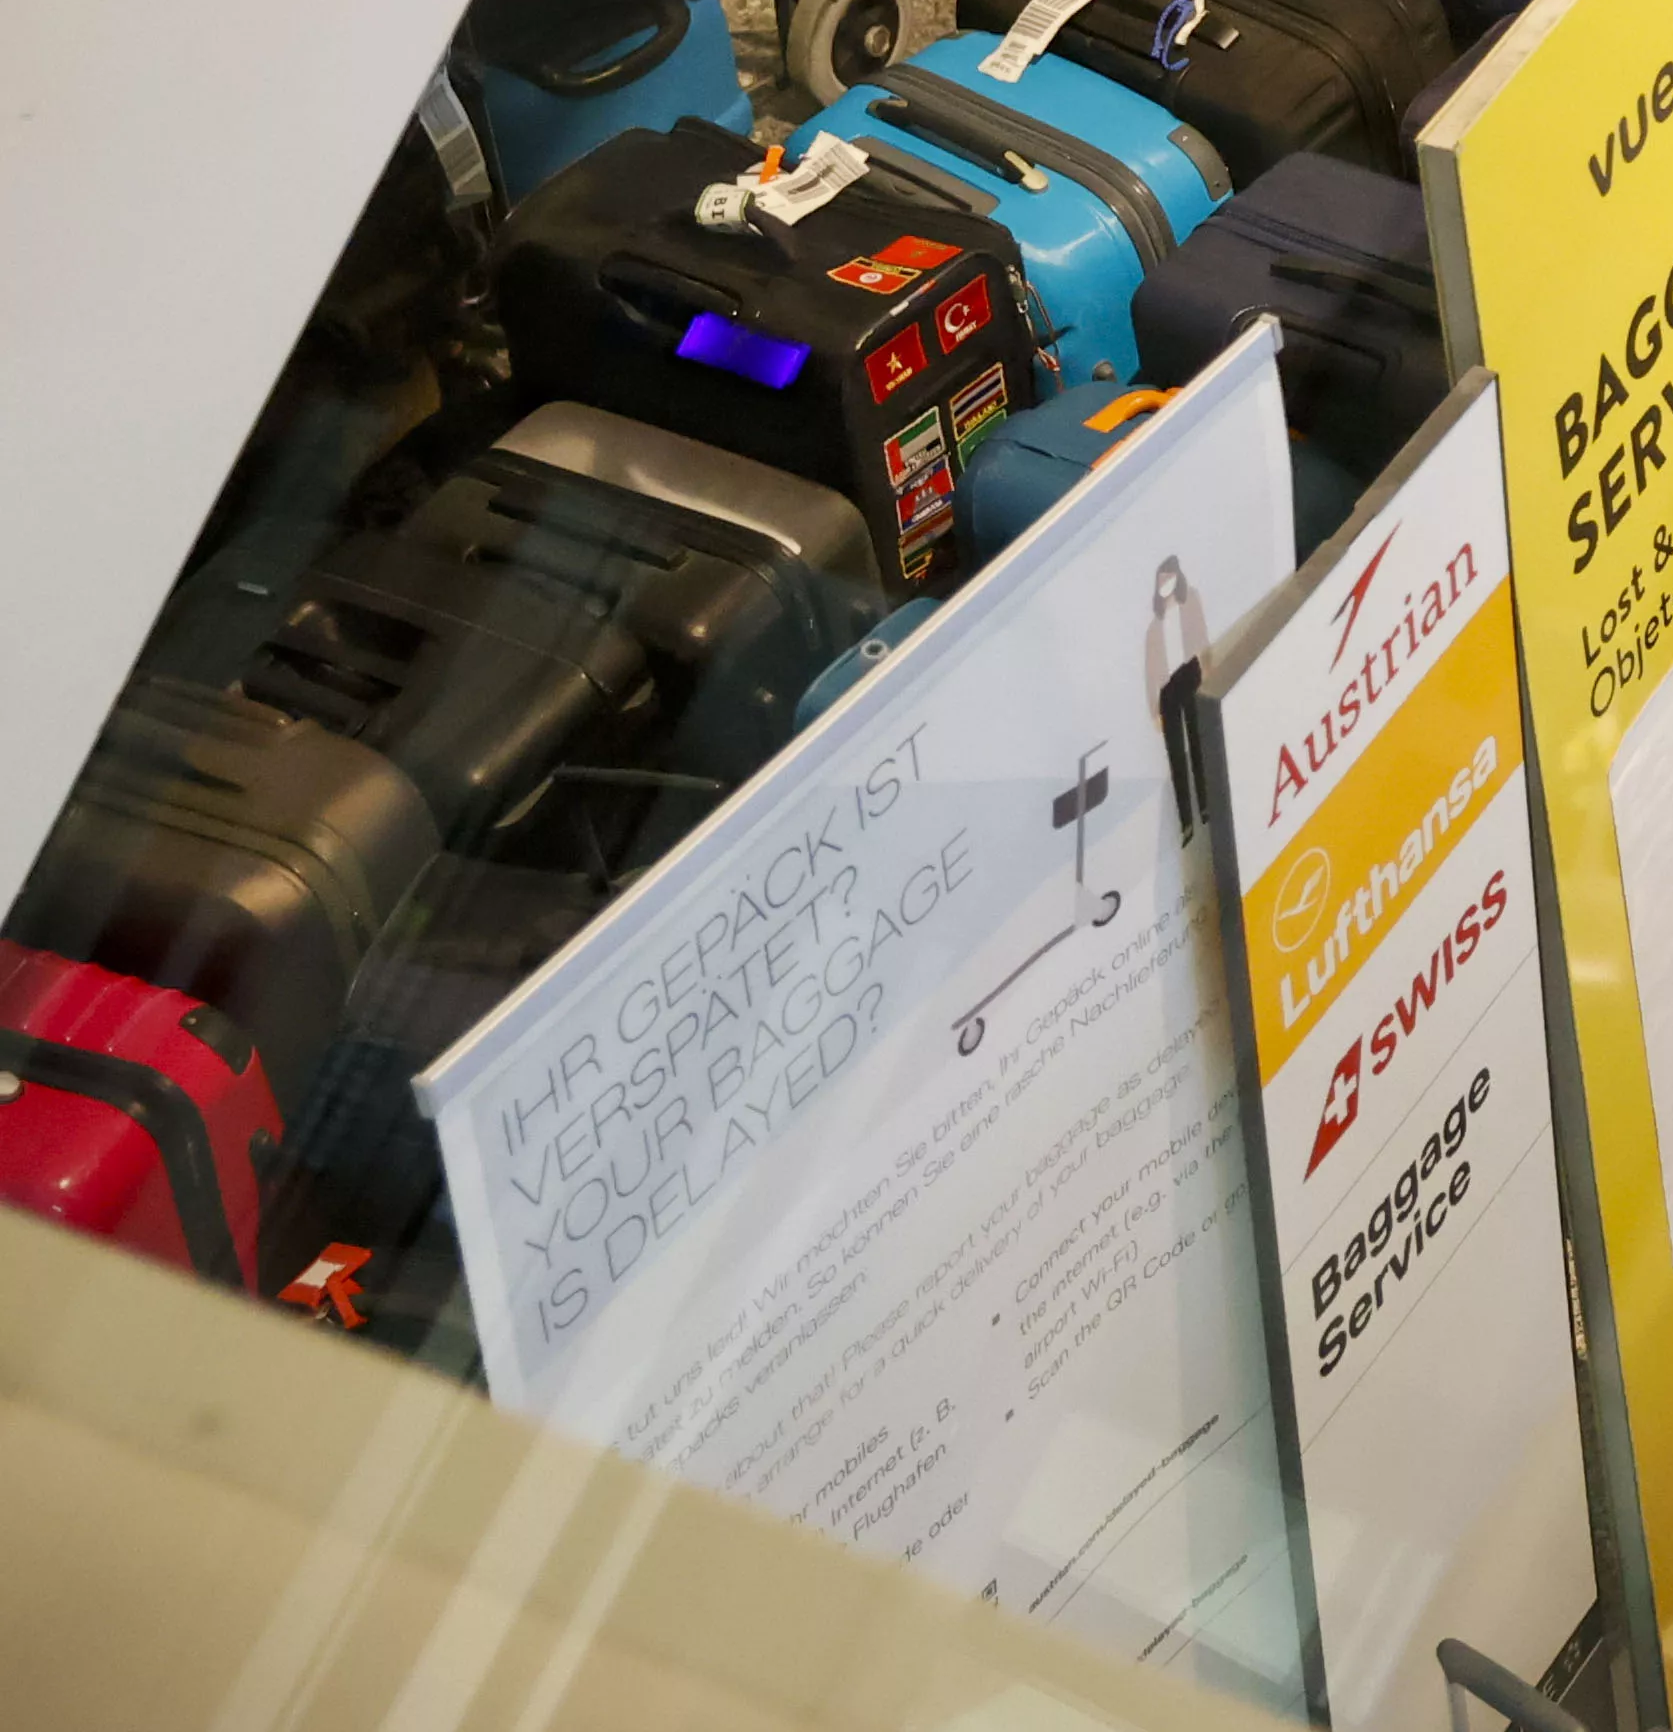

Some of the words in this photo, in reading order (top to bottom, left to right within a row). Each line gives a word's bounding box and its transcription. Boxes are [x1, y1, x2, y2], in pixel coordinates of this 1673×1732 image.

[1267, 542, 1478, 827] Austrian
[1581, 564, 1646, 670] Lost
[500, 1033, 602, 1156] IHR
[616, 805, 844, 1044] GEPÄCK
[855, 721, 930, 833] IST
[1277, 734, 1499, 1030] Lufthansa
[510, 864, 859, 1207] VERSPÄTET?
[524, 1097, 693, 1274] YOUR
[707, 828, 974, 1112] BAGGAGE
[537, 1267, 588, 1344] IS
[604, 982, 886, 1282] DELAYED?
[751, 1265, 790, 1320] Wir
[795, 1167, 891, 1276] möchten
[893, 1132, 928, 1183] Sie
[931, 1065, 995, 1148] bitten,
[1024, 957, 1105, 1049] Gepäck
[1109, 903, 1170, 976] online
[716, 1292, 801, 1391] melden.
[806, 1256, 837, 1302] So
[840, 1177, 918, 1270] können
[921, 1140, 956, 1191] Sie
[958, 1100, 1000, 1154] eine
[1002, 1031, 1066, 1106] rasche
[755, 1403, 836, 1498] arrange
[890, 1292, 945, 1365] quick
[949, 1214, 1024, 1307] delivery
[1048, 1145, 1090, 1202] your
[1095, 1046, 1192, 1164] baggage
[840, 1287, 911, 1375] Please
[913, 1228, 976, 1308] report
[980, 1184, 1021, 1243] your
[1023, 1090, 1112, 1192] baggage
[1114, 1065, 1142, 1106] as
[1012, 1215, 1087, 1306] Connect
[1092, 1175, 1132, 1231] your
[1137, 1111, 1203, 1190] mobile
[1018, 1296, 1048, 1340] the
[1050, 1221, 1118, 1302] internet
[1122, 1176, 1167, 1238] (e.g.
[1172, 1155, 1199, 1192] via
[1204, 1122, 1233, 1161] the
[1021, 1298, 1078, 1372] airport
[1081, 1234, 1139, 1308] Wi-Fi)
[1026, 1344, 1071, 1403] Scan
[1074, 1308, 1102, 1348] the
[1105, 1270, 1138, 1317] QR
[1142, 1217, 1197, 1289] Code
[1311, 1065, 1491, 1322] Baggage
[1318, 1159, 1471, 1378] Service
[813, 1418, 890, 1508] mobiles
[829, 1440, 905, 1528] Internet
[851, 1436, 948, 1548] Flughafen
[927, 1487, 970, 1542] oder
